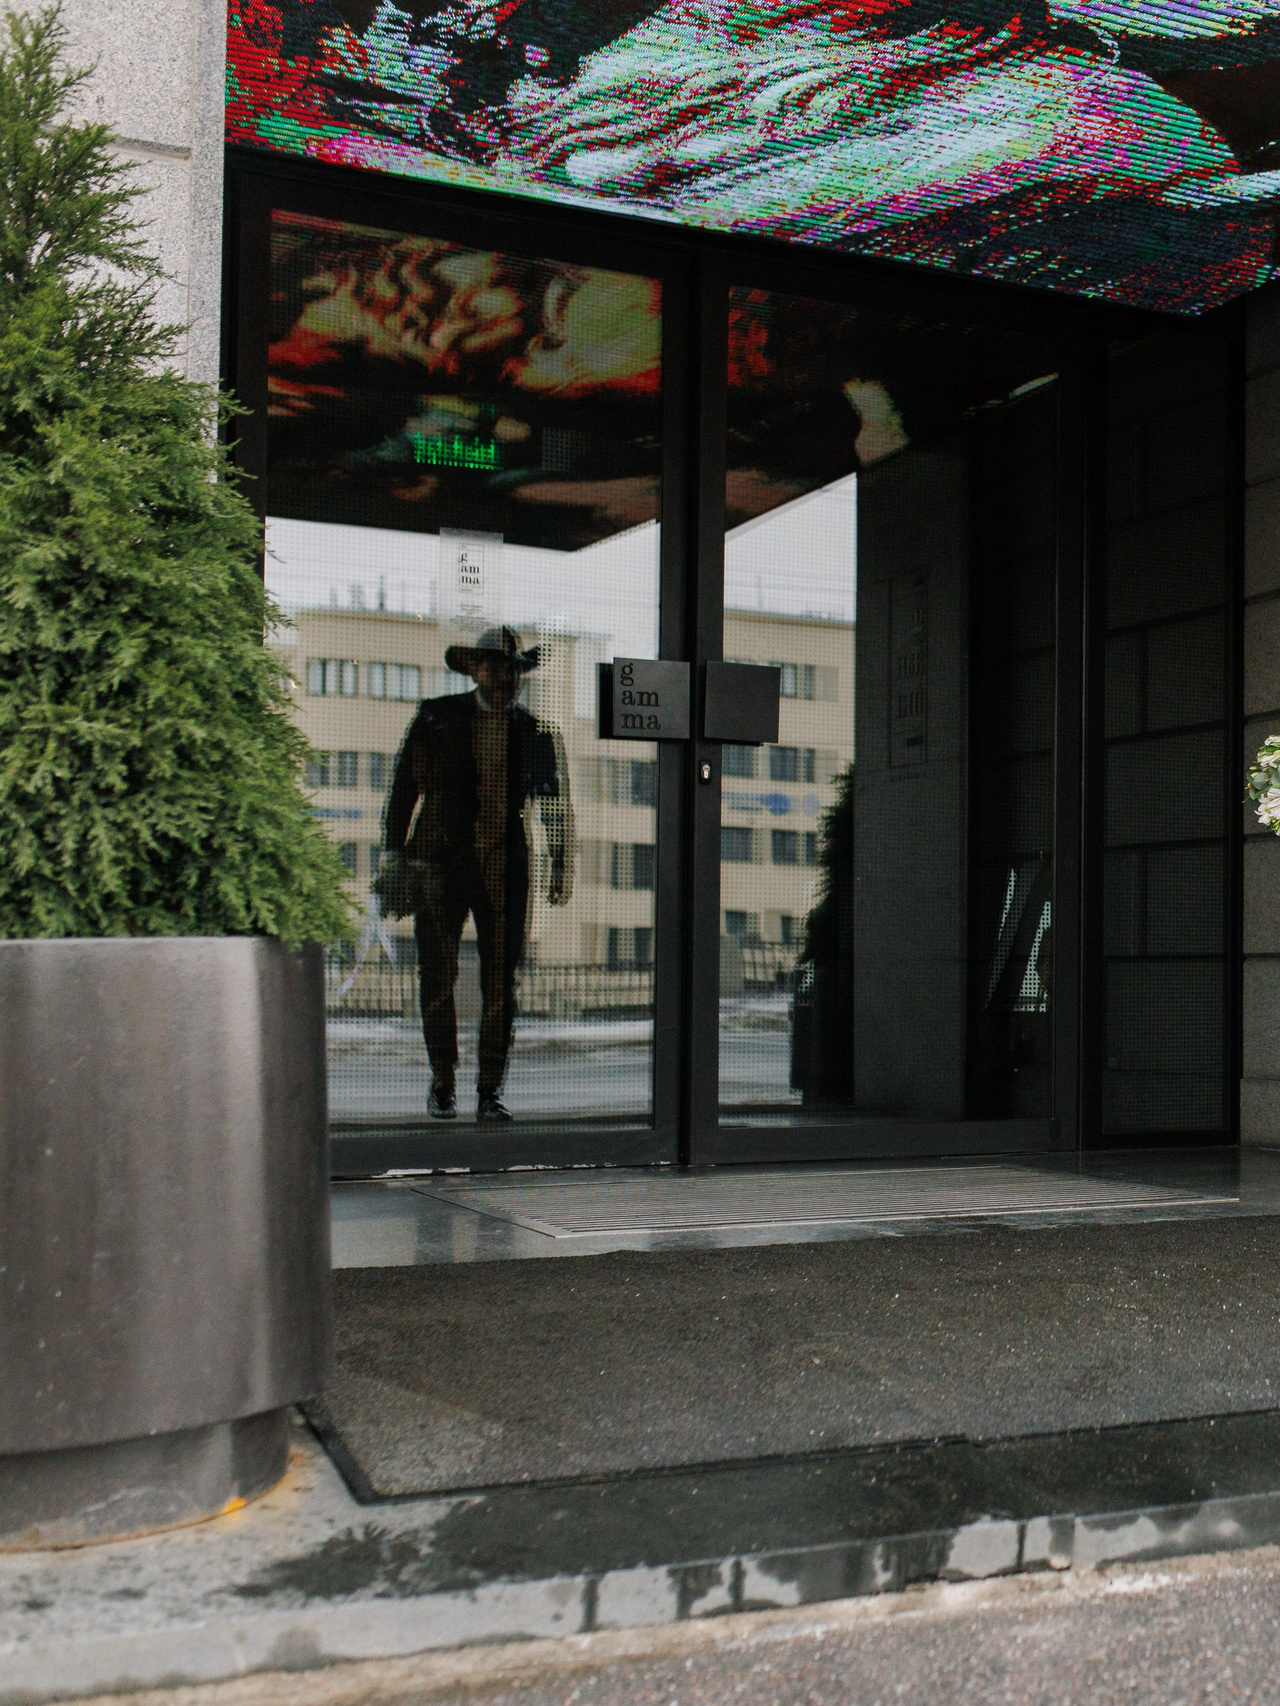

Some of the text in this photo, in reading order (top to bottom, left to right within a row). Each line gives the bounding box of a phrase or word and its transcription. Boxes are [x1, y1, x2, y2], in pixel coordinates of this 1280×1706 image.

[461, 565, 480, 574] am
[461, 576, 480, 585] ma
[620, 662, 634, 687] g
[620, 689, 661, 707] am
[620, 713, 661, 731] ma
